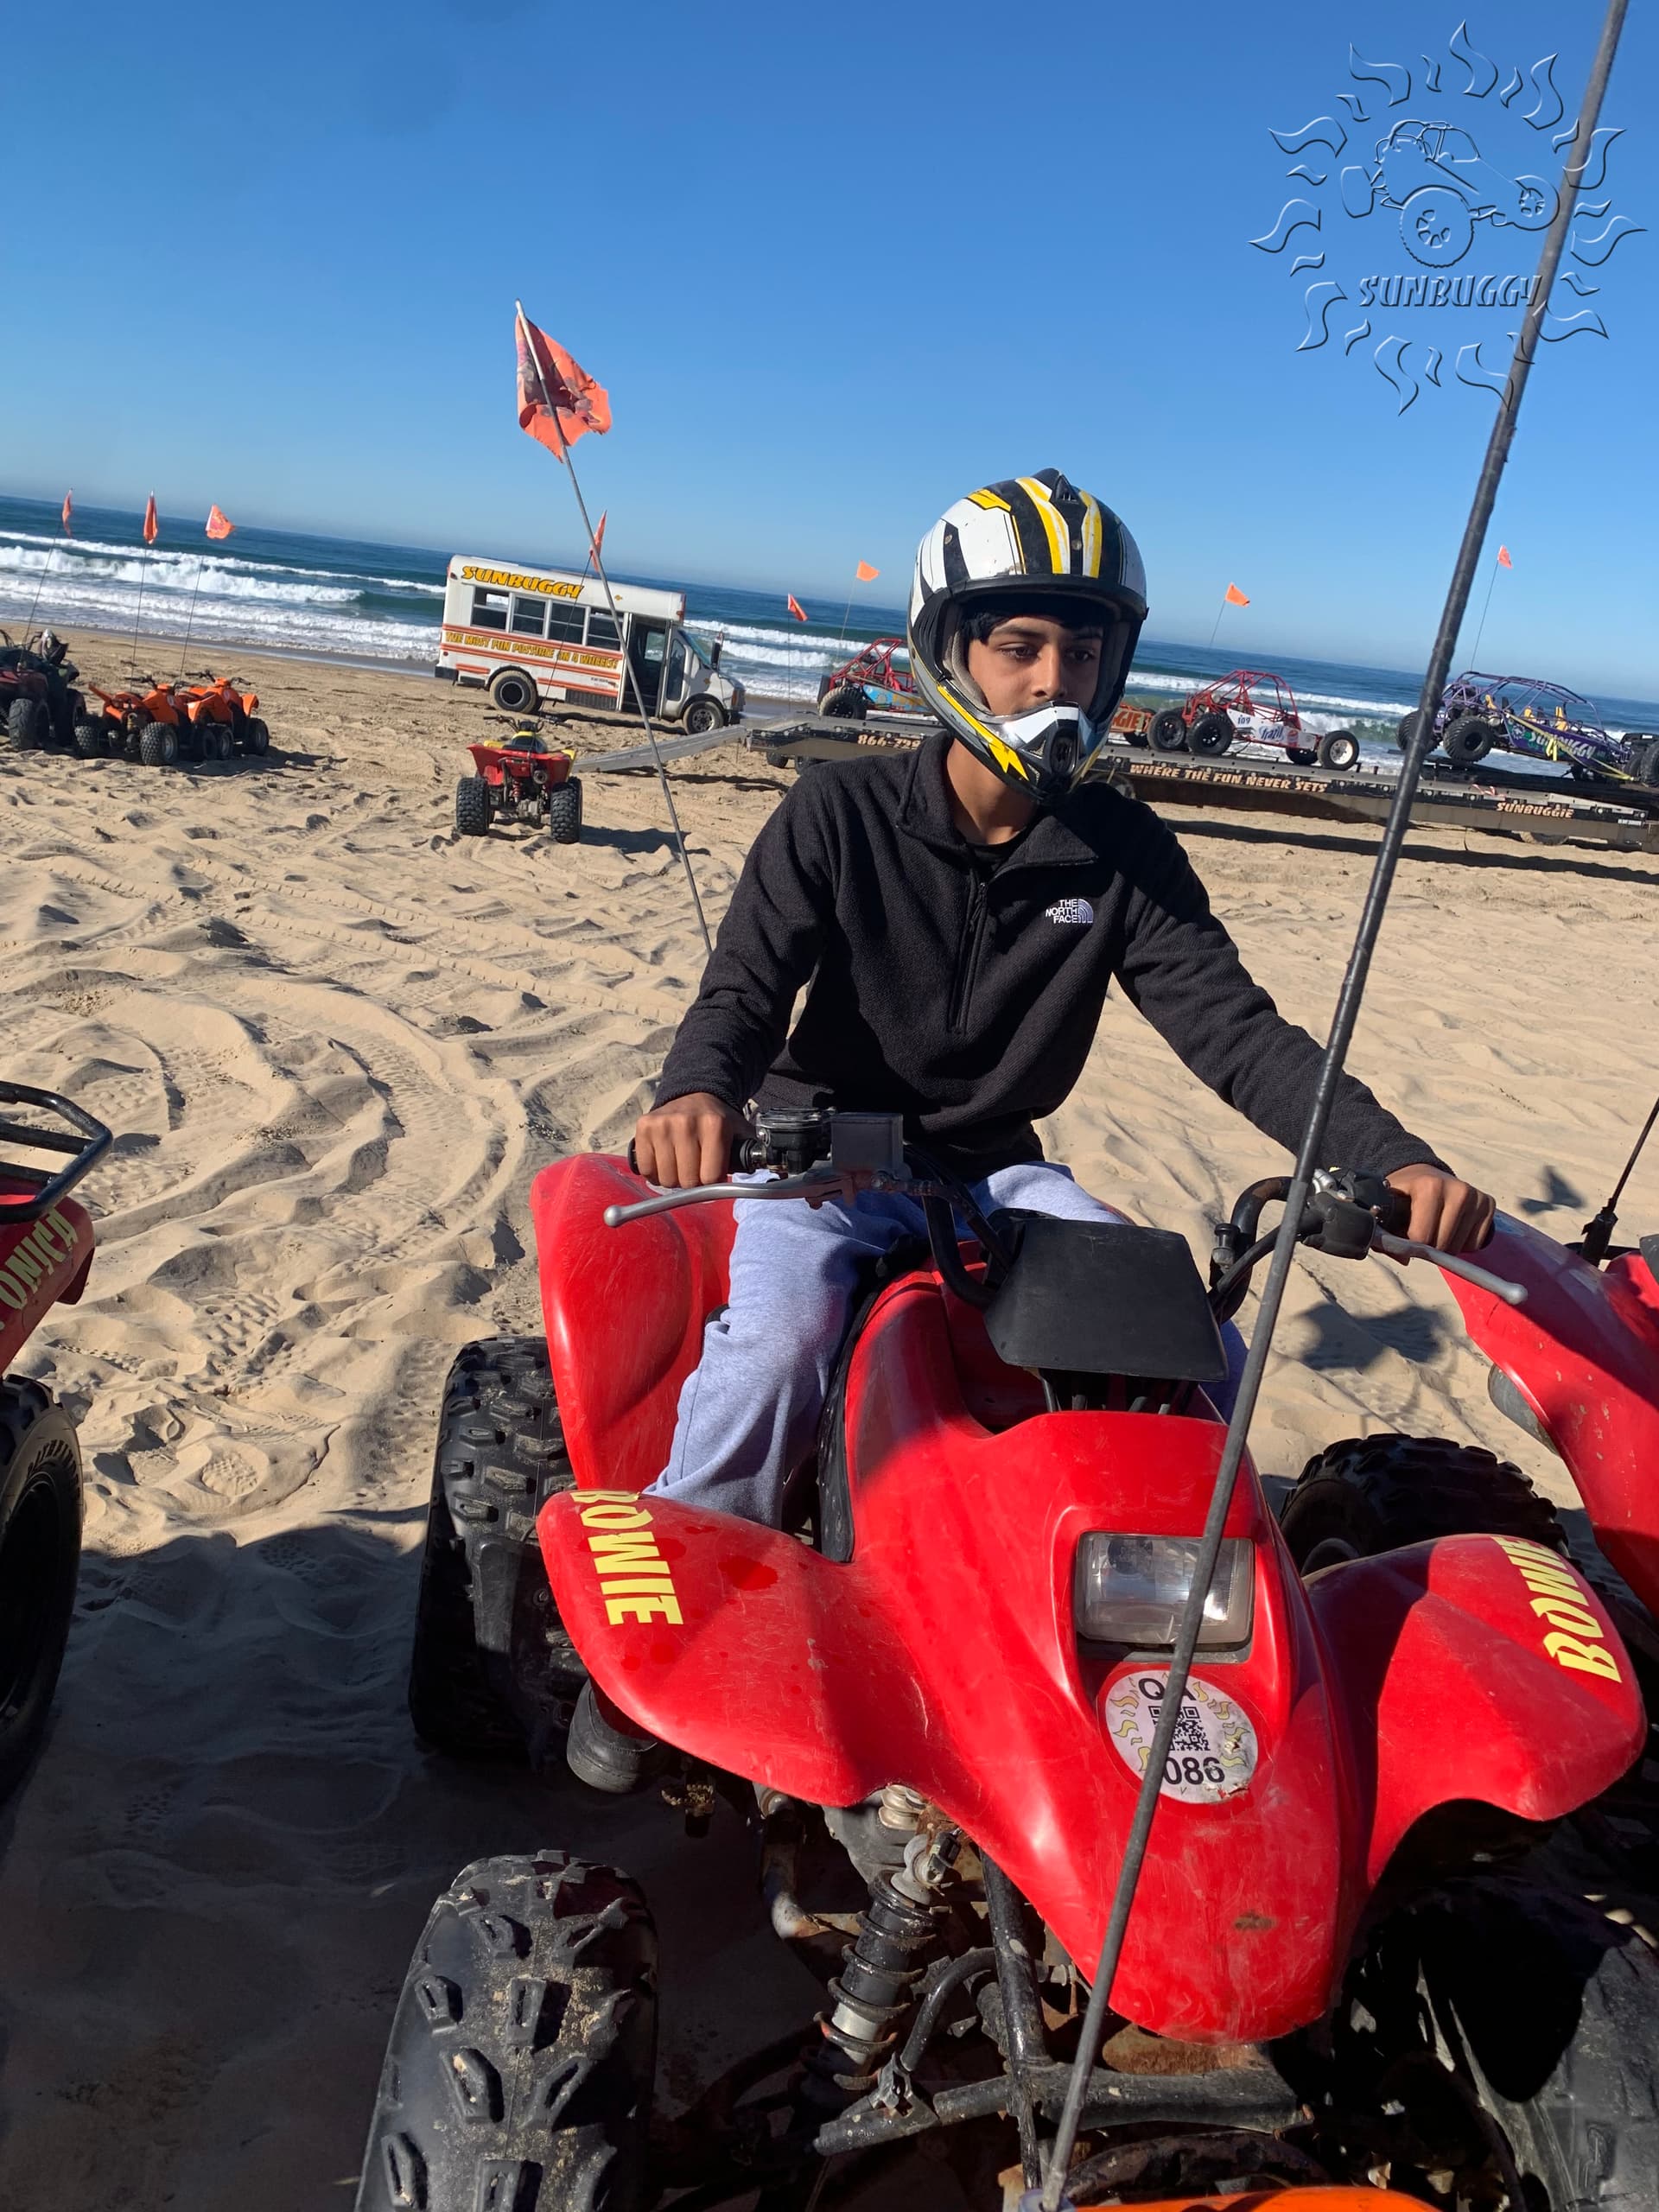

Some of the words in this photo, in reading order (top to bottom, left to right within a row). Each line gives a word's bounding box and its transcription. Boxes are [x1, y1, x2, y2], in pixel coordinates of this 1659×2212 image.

[461, 566, 584, 598] SUNBUGGY
[1129, 764, 1180, 778] WHERE
[1184, 768, 1211, 781] THE
[1213, 772, 1242, 785] FUN
[1245, 774, 1291, 789] NEVER
[1294, 780, 1328, 792] SETS
[1496, 802, 1574, 818] SUNBUGGIE
[1045, 906, 1077, 917] NORTH
[1058, 899, 1077, 907] THE
[1053, 915, 1078, 924] FACE
[0, 1207, 79, 1332] ONICA
[570, 1491, 684, 1625] BOWIE
